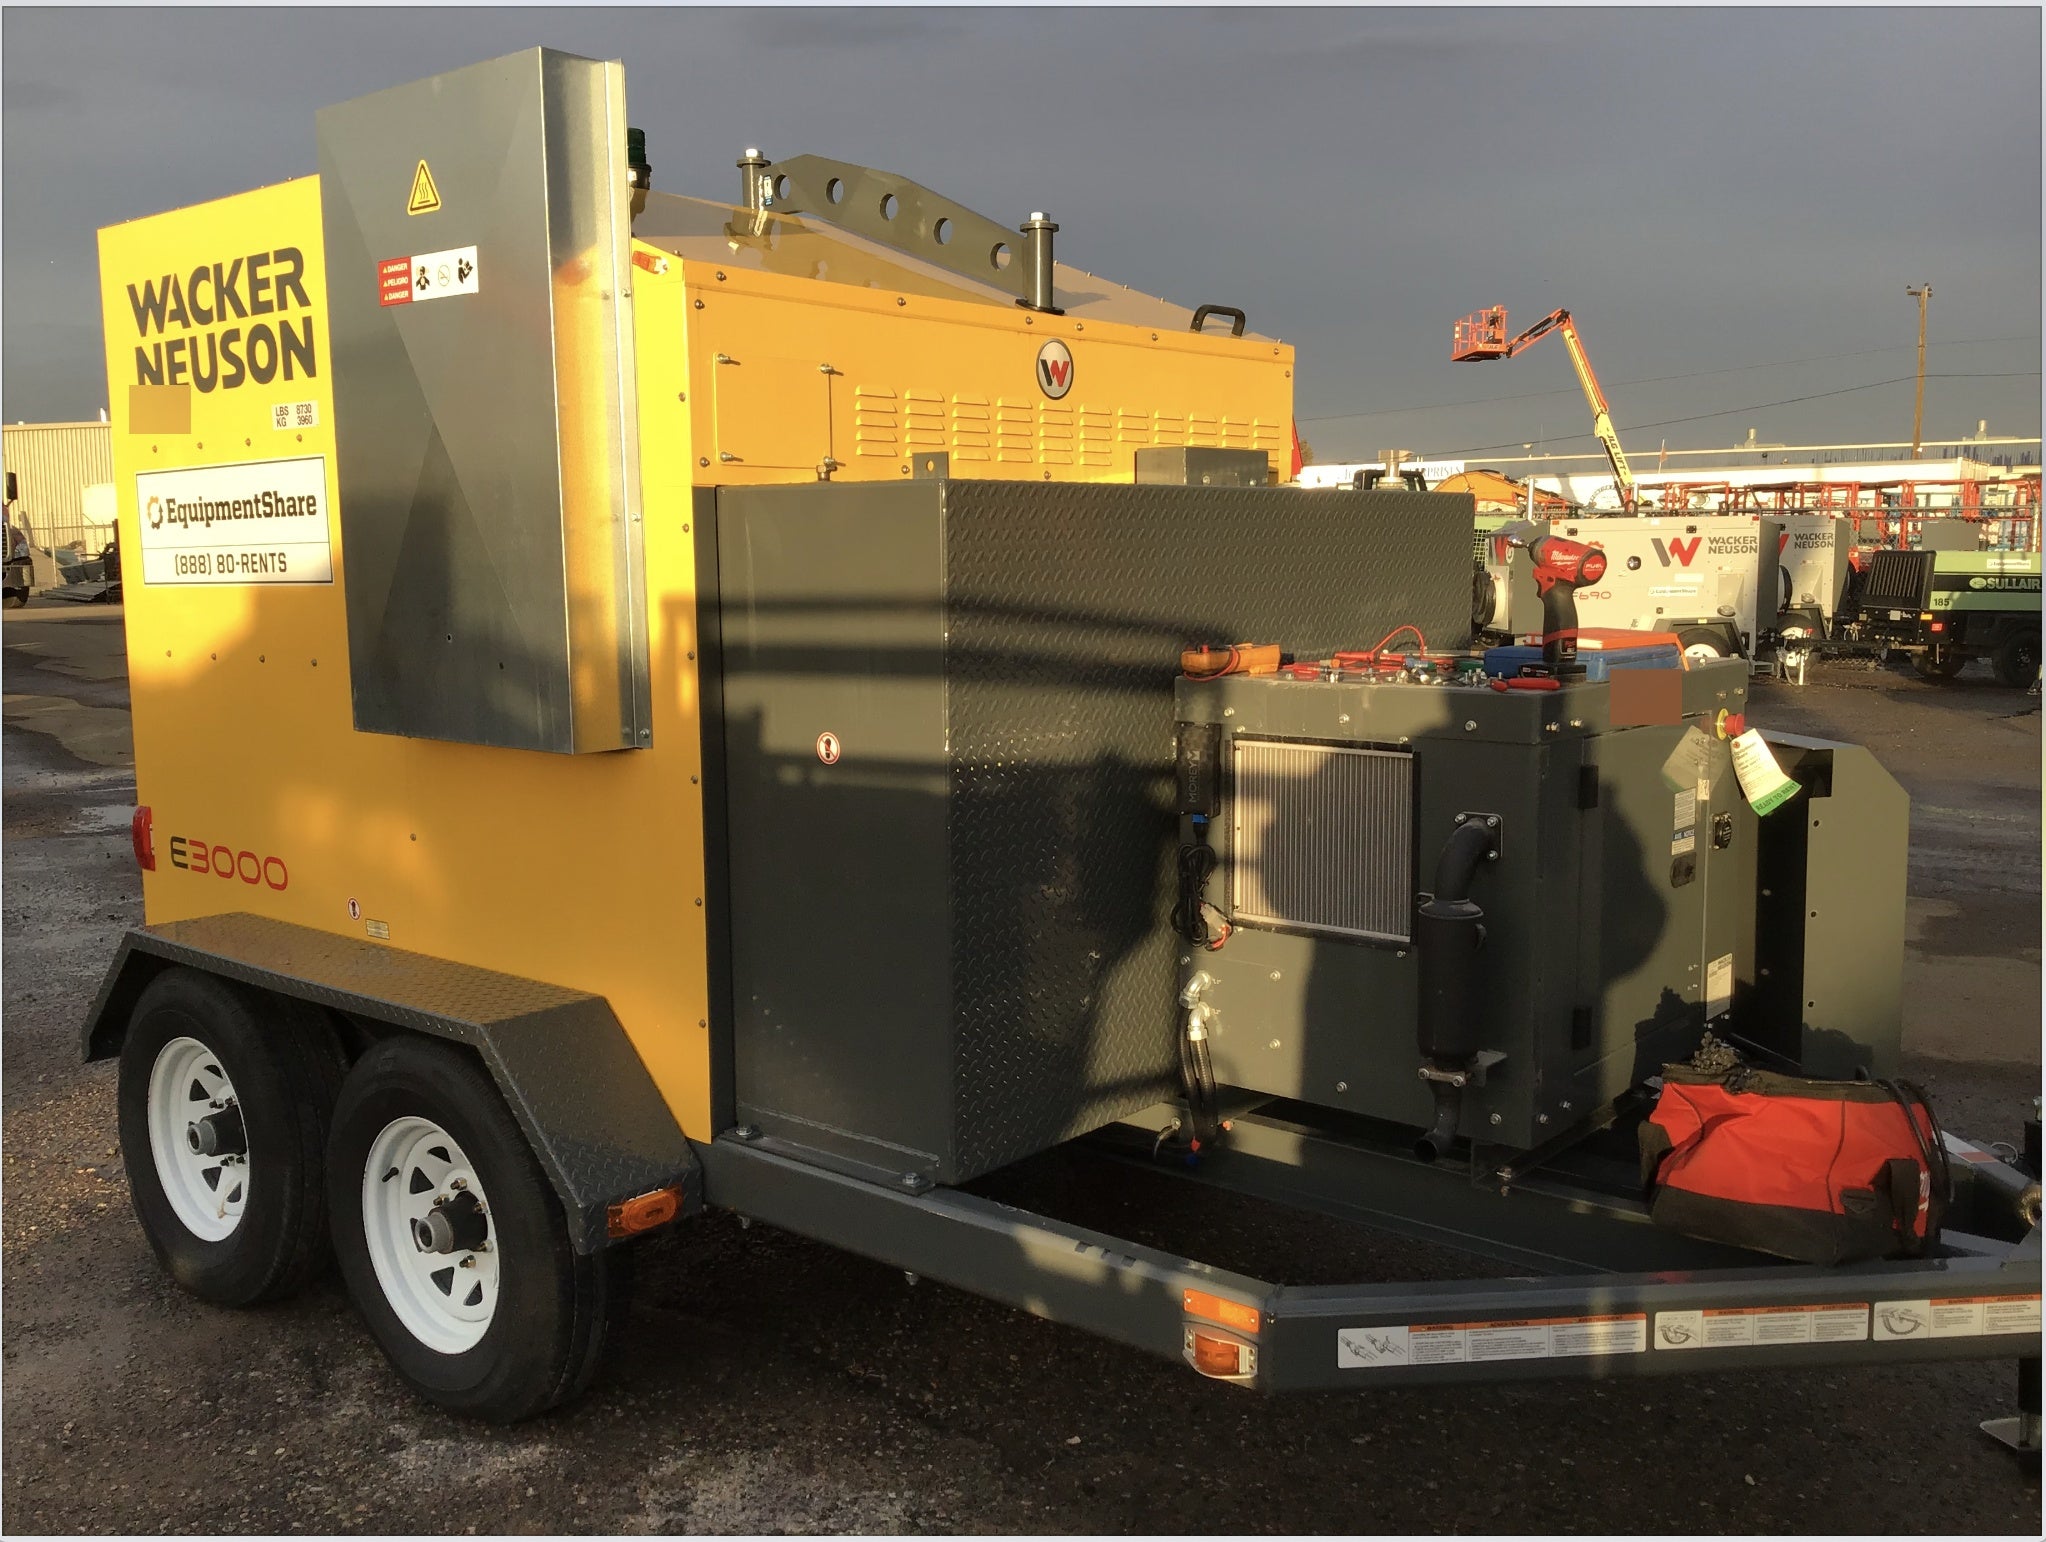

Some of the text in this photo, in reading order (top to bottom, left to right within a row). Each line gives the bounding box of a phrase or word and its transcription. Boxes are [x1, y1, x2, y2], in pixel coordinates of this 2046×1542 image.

[387, 262, 408, 273] DANGER
[387, 276, 409, 287] PELIGRO
[126, 247, 312, 338] WACKER
[388, 290, 409, 301] DANGER
[134, 315, 316, 394] NEUSON
[275, 403, 312, 417] LBS 8730
[276, 415, 313, 427] KG 3960
[1607, 434, 1627, 471] JLG LIFT
[165, 490, 317, 529] EquipmentShare
[1708, 536, 1758, 545] WACKER
[1794, 532, 1834, 541] WACKER
[1708, 545, 1758, 554] NEUSON
[1794, 540, 1834, 549] NEUSON
[174, 552, 287, 577] (888) 80-RENTS
[1986, 577, 2041, 590] SULLAIR
[1933, 598, 1950, 607] 185
[170, 836, 289, 891] E3000
